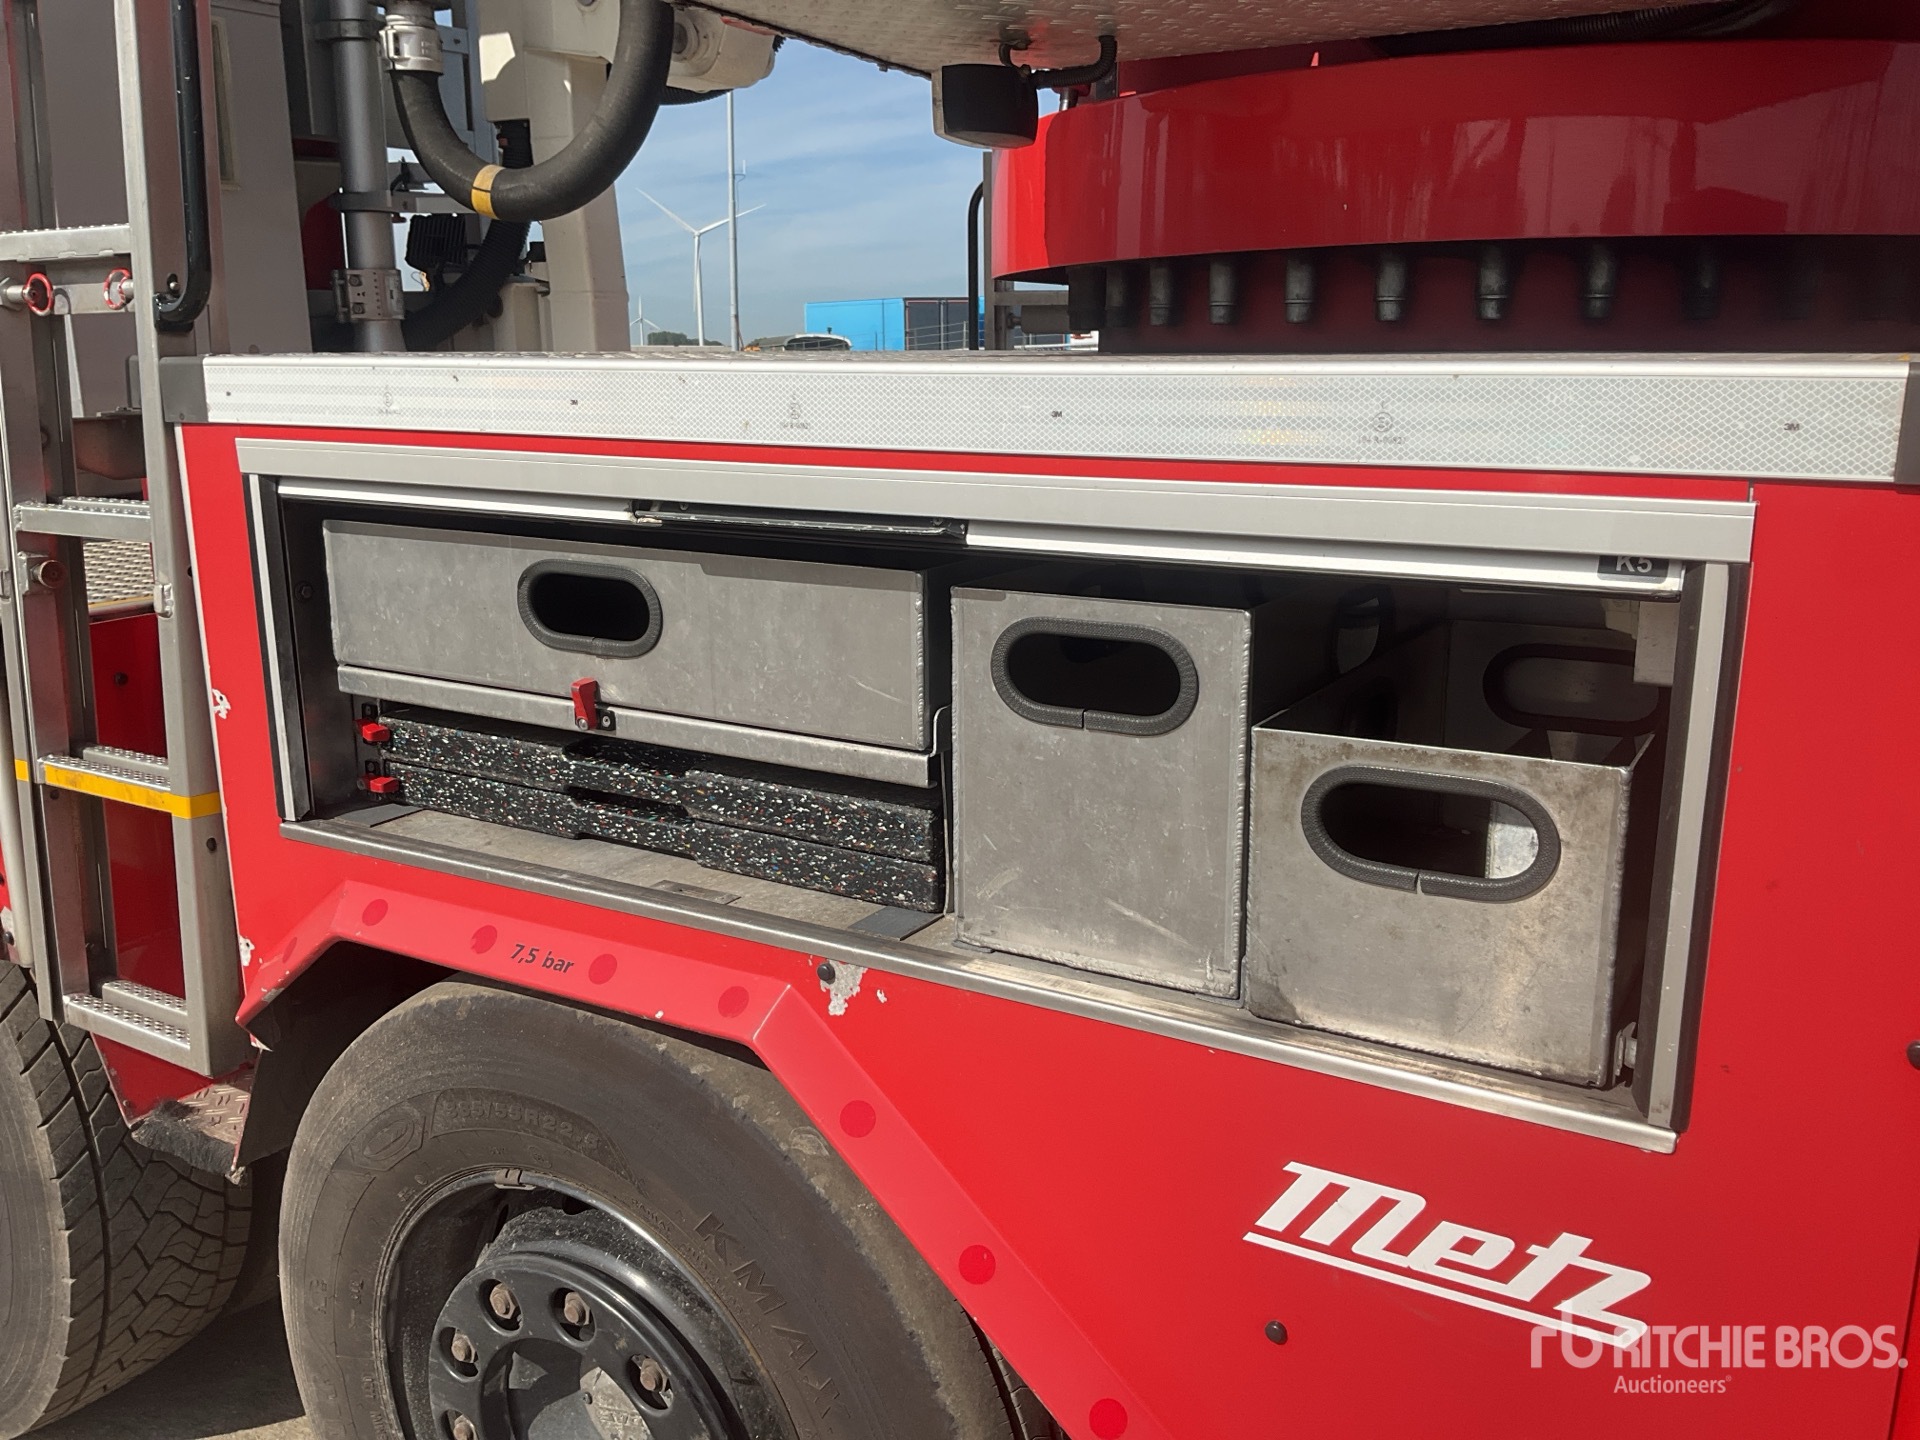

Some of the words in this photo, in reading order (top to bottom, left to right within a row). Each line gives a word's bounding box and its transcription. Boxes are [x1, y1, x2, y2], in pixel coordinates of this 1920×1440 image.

[1051, 410, 1063, 418] 3M
[1783, 422, 1800, 431] 3M
[1615, 555, 1653, 573] K5
[510, 943, 540, 964] 7,5
[541, 950, 575, 974] bar
[692, 1210, 852, 1420] KMAX
